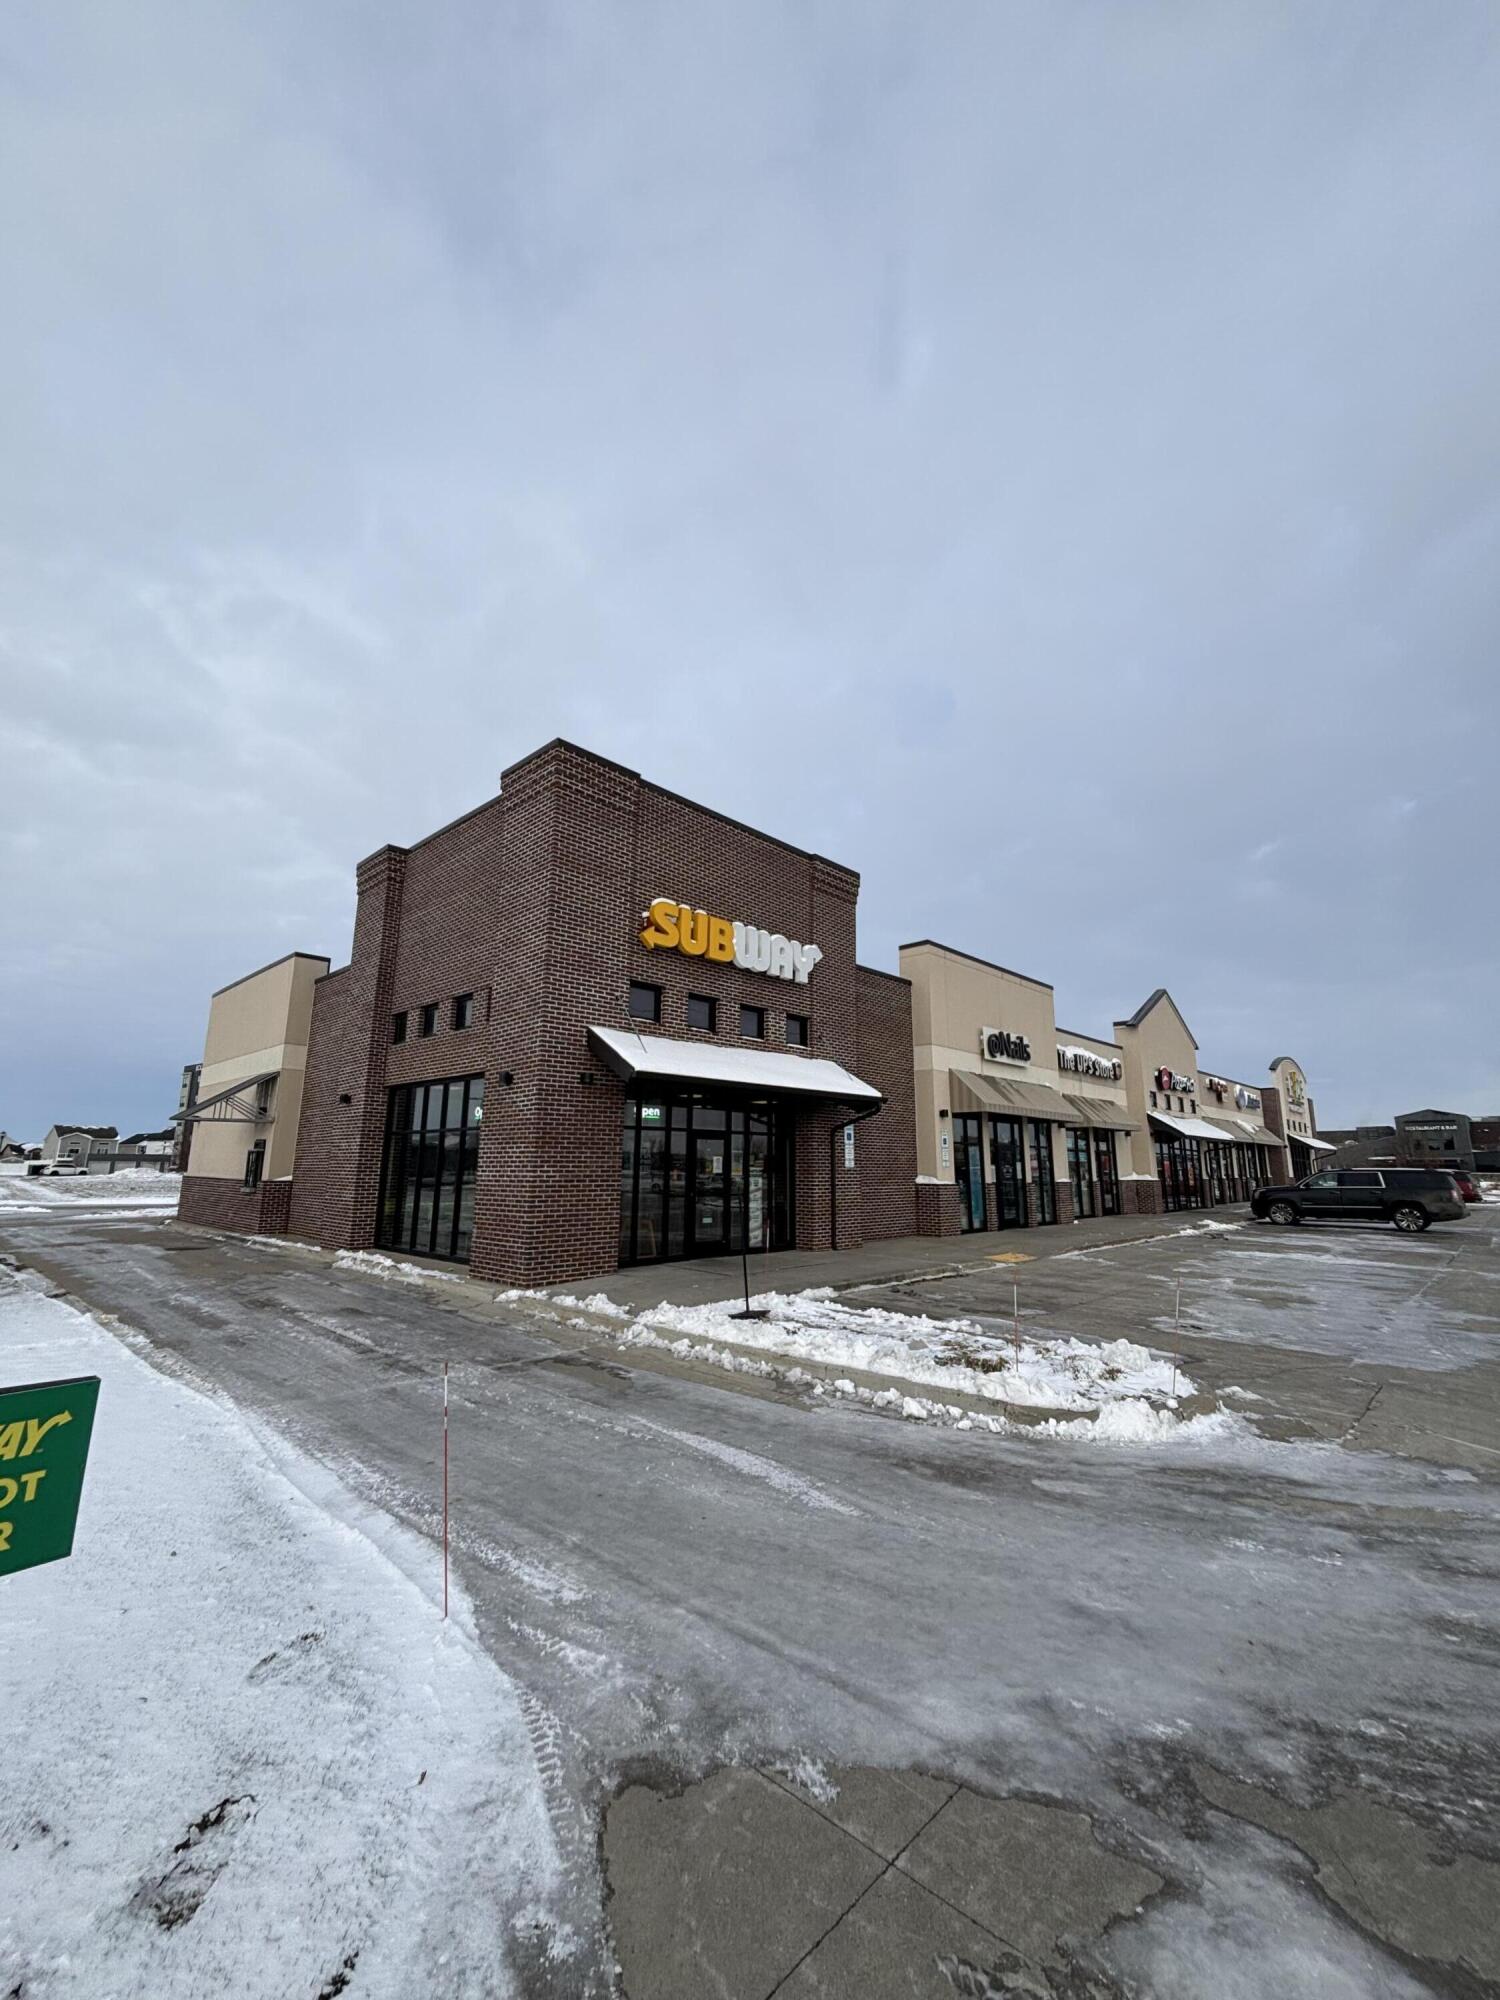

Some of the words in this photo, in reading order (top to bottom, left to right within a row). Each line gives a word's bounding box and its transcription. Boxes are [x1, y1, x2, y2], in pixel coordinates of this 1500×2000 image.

[640, 897, 823, 984] SUBWAY
[987, 1031, 1031, 1061] @Nails
[1058, 1048, 1075, 1070] The
[1075, 1054, 1094, 1075] UPS
[0, 1410, 73, 1461] AY
